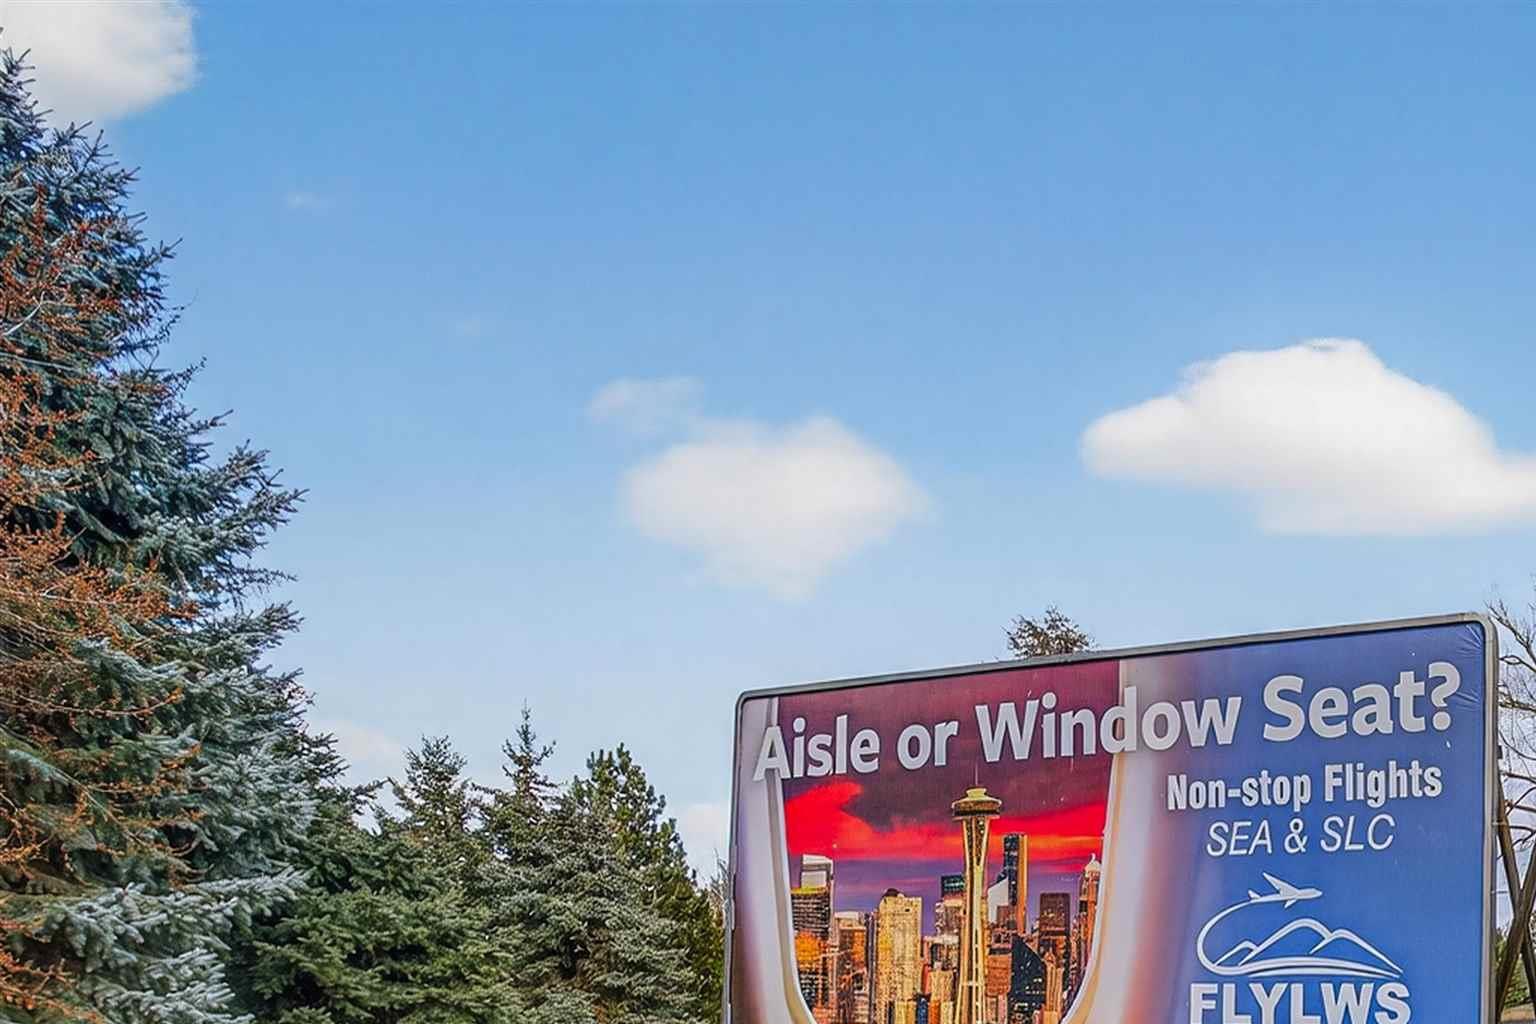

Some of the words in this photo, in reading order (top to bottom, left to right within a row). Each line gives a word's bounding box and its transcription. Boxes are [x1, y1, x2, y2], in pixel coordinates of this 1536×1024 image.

[753, 715, 880, 781] Aisle
[897, 720, 958, 770] or
[975, 686, 1241, 763] Window
[1263, 661, 1461, 742] Seat?
[1167, 770, 1311, 811] Non-stop
[1324, 760, 1443, 807] Flights
[1206, 820, 1273, 856] SEA
[1284, 818, 1308, 853] &
[1320, 814, 1396, 851] SLC
